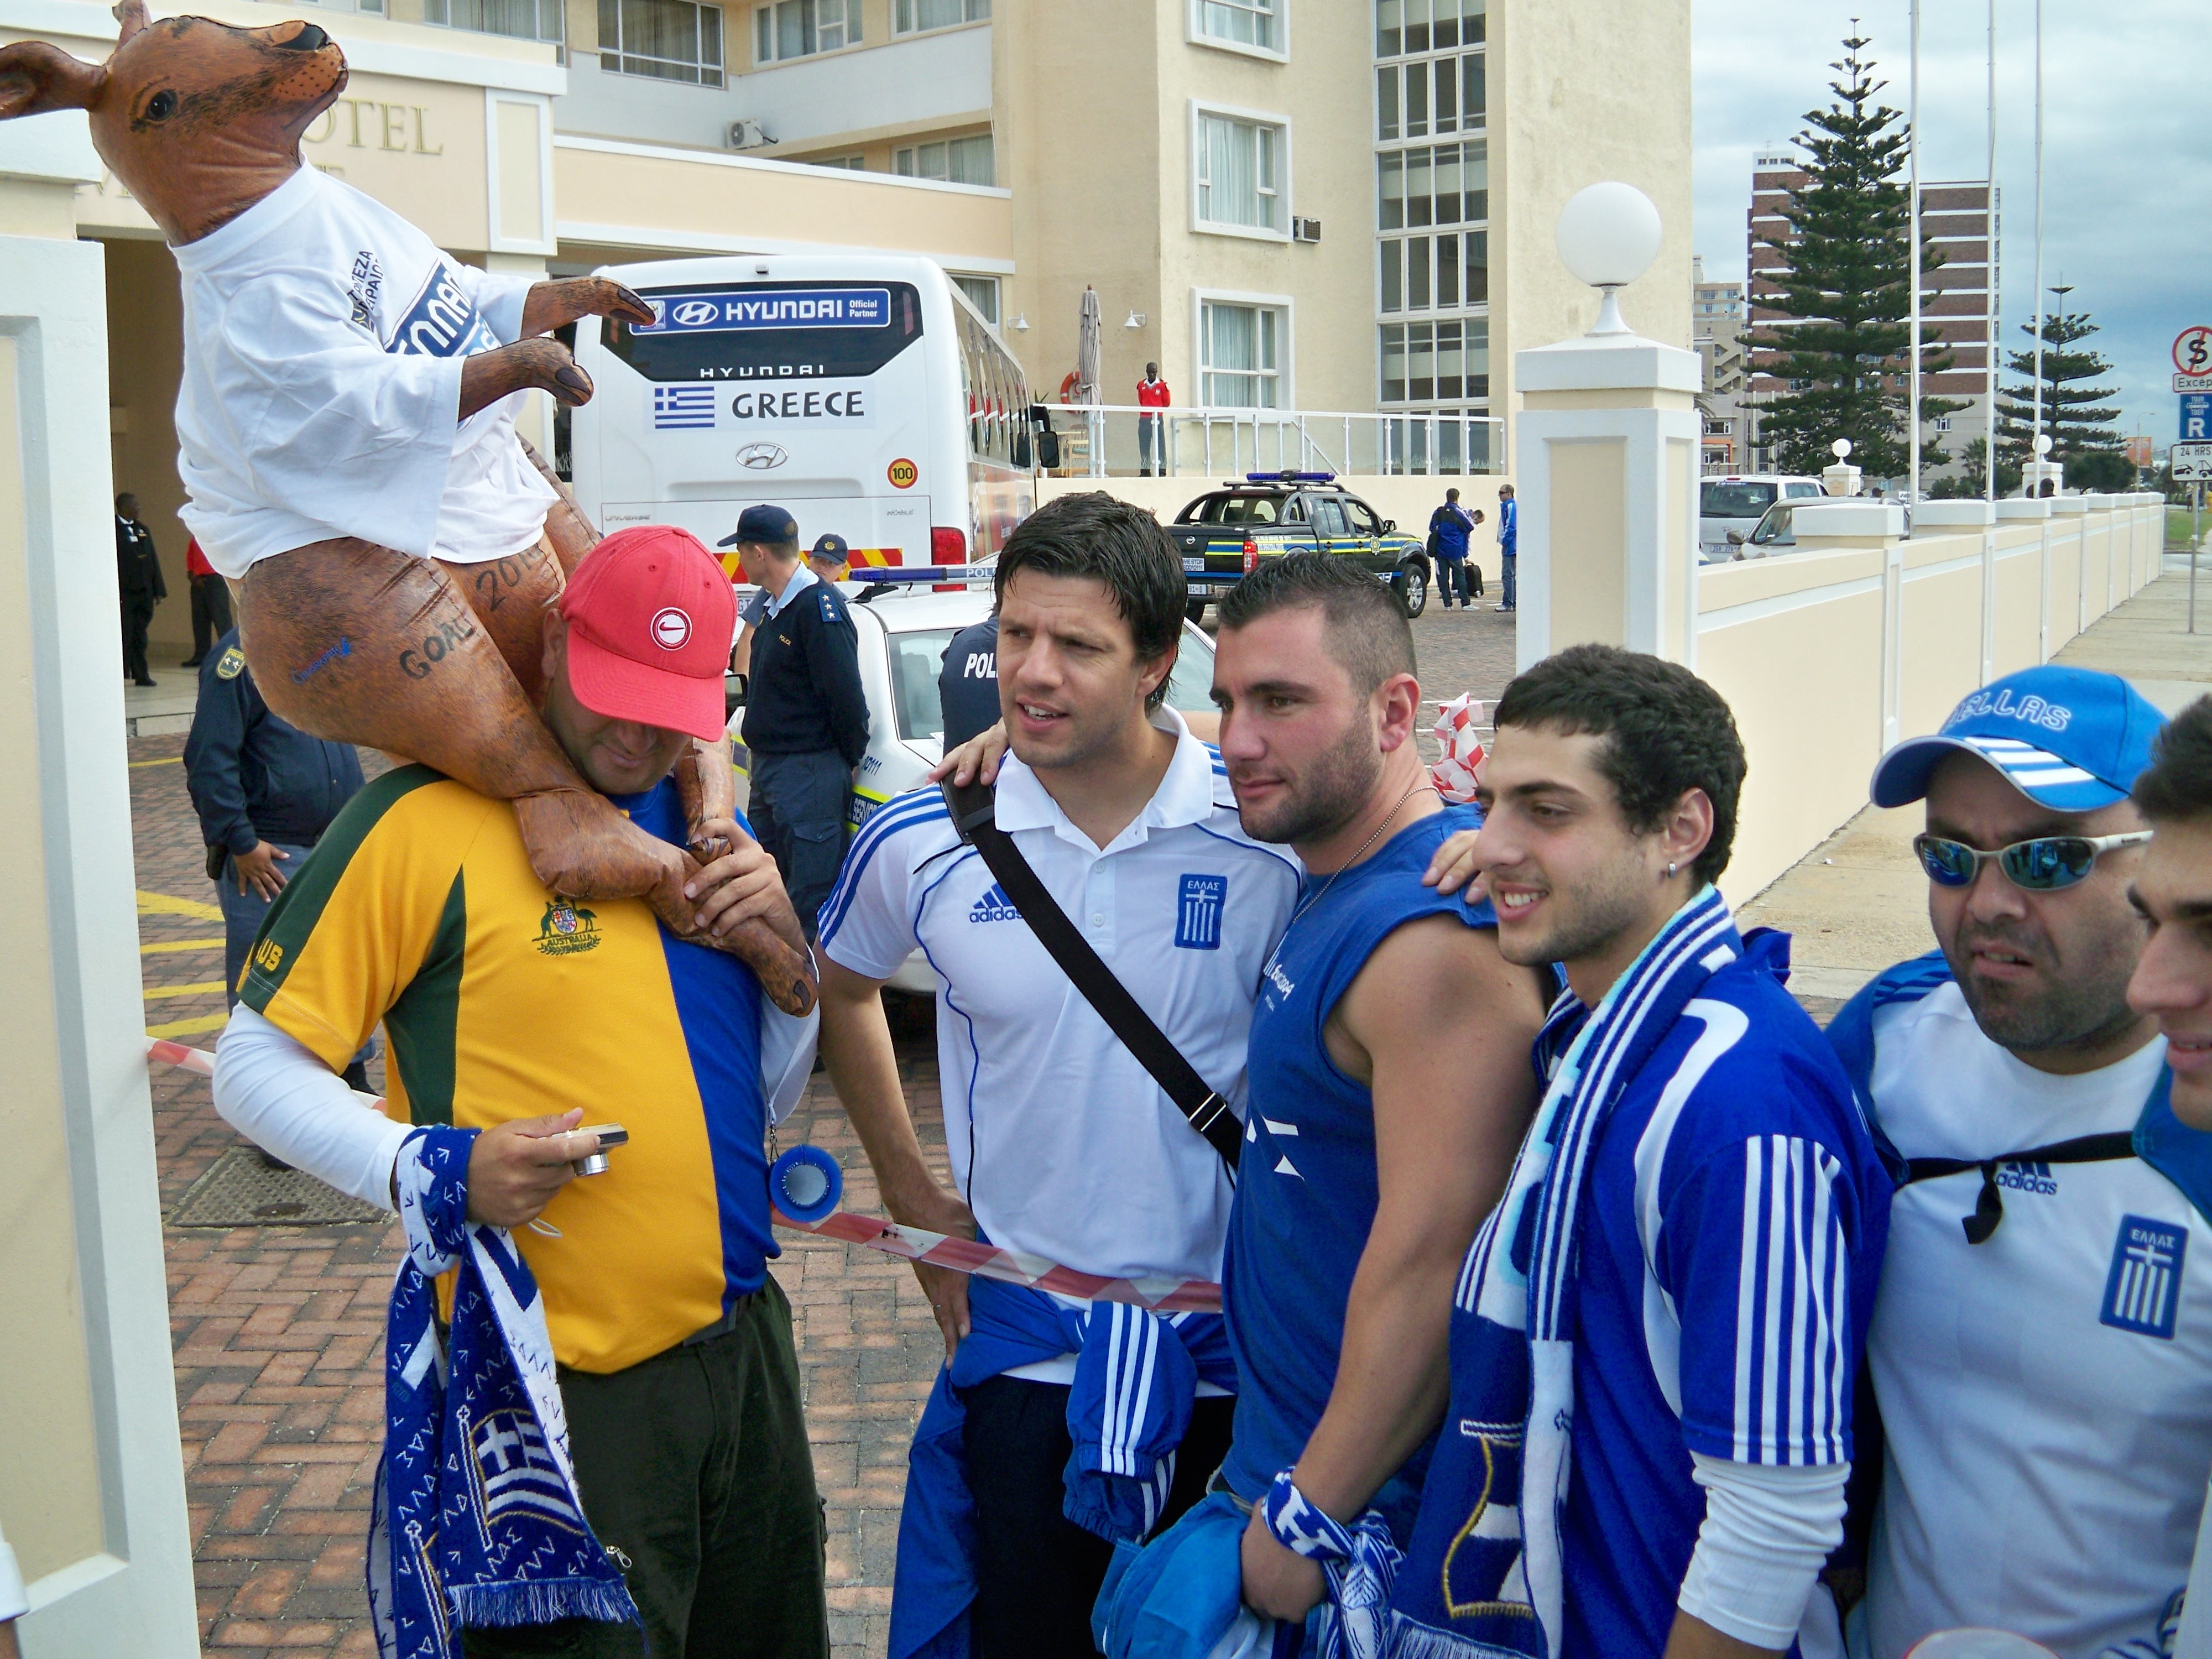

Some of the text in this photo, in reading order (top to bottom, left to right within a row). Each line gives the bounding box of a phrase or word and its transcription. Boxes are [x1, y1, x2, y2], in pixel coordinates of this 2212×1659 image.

[302, 98, 443, 155] OTEL
[726, 300, 842, 321] HYUNDAI
[849, 299, 878, 309] Official
[849, 309, 878, 318] Partner
[700, 364, 823, 378] HYUNDAI
[732, 390, 864, 419] GREECE
[2188, 417, 2205, 437] R
[2180, 446, 2211, 456] 24 HRS
[893, 467, 913, 480] 100
[964, 653, 998, 679] POL
[1187, 880, 1220, 891] ΕΛΛΑΣ
[547, 933, 592, 946] AUSTRALIA
[256, 938, 283, 971] US
[1995, 1171, 2057, 1195] adidas
[2131, 1228, 2176, 1249] ΕΛΛΑΣ
